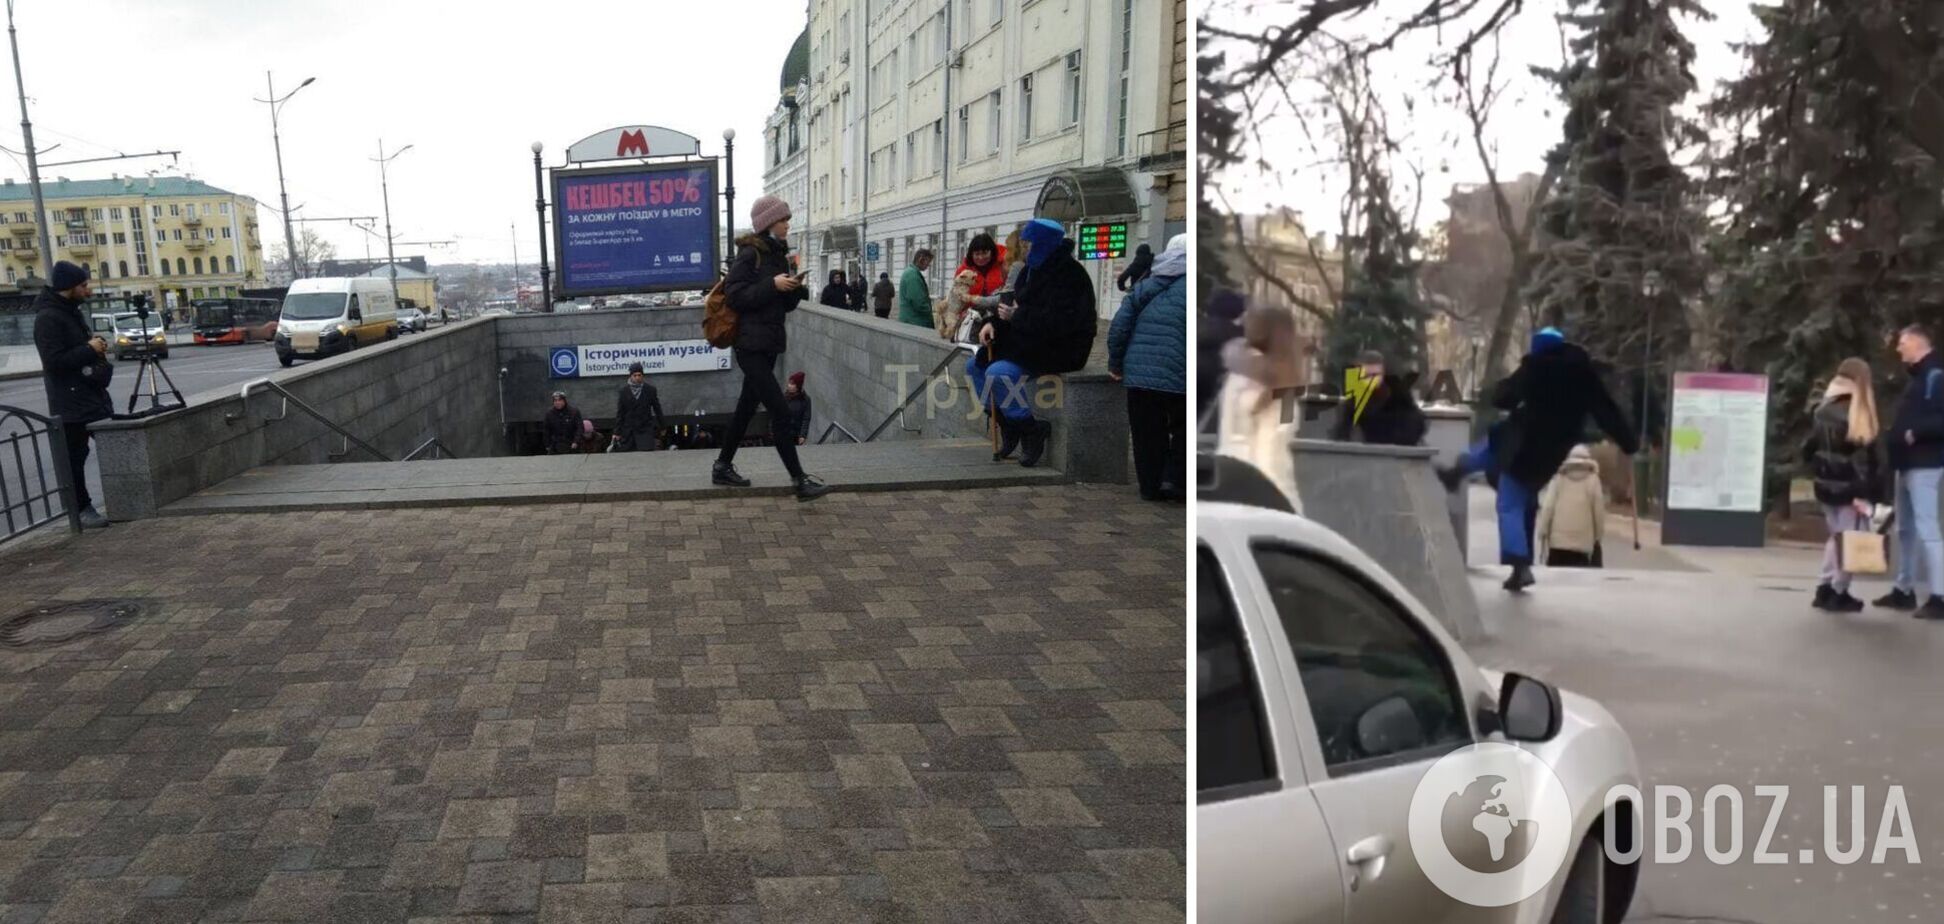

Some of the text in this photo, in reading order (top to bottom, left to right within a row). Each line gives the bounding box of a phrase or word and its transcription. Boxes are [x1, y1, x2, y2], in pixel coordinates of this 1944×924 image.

[566, 178, 700, 210] КЕШБЕК 50%
[568, 207, 702, 224] ЗА КОЖНУ ПОЇЗДКУ В МЕТРО
[667, 255, 685, 263] VISA
[584, 343, 713, 360] Історичний музей
[720, 358, 728, 368] 2
